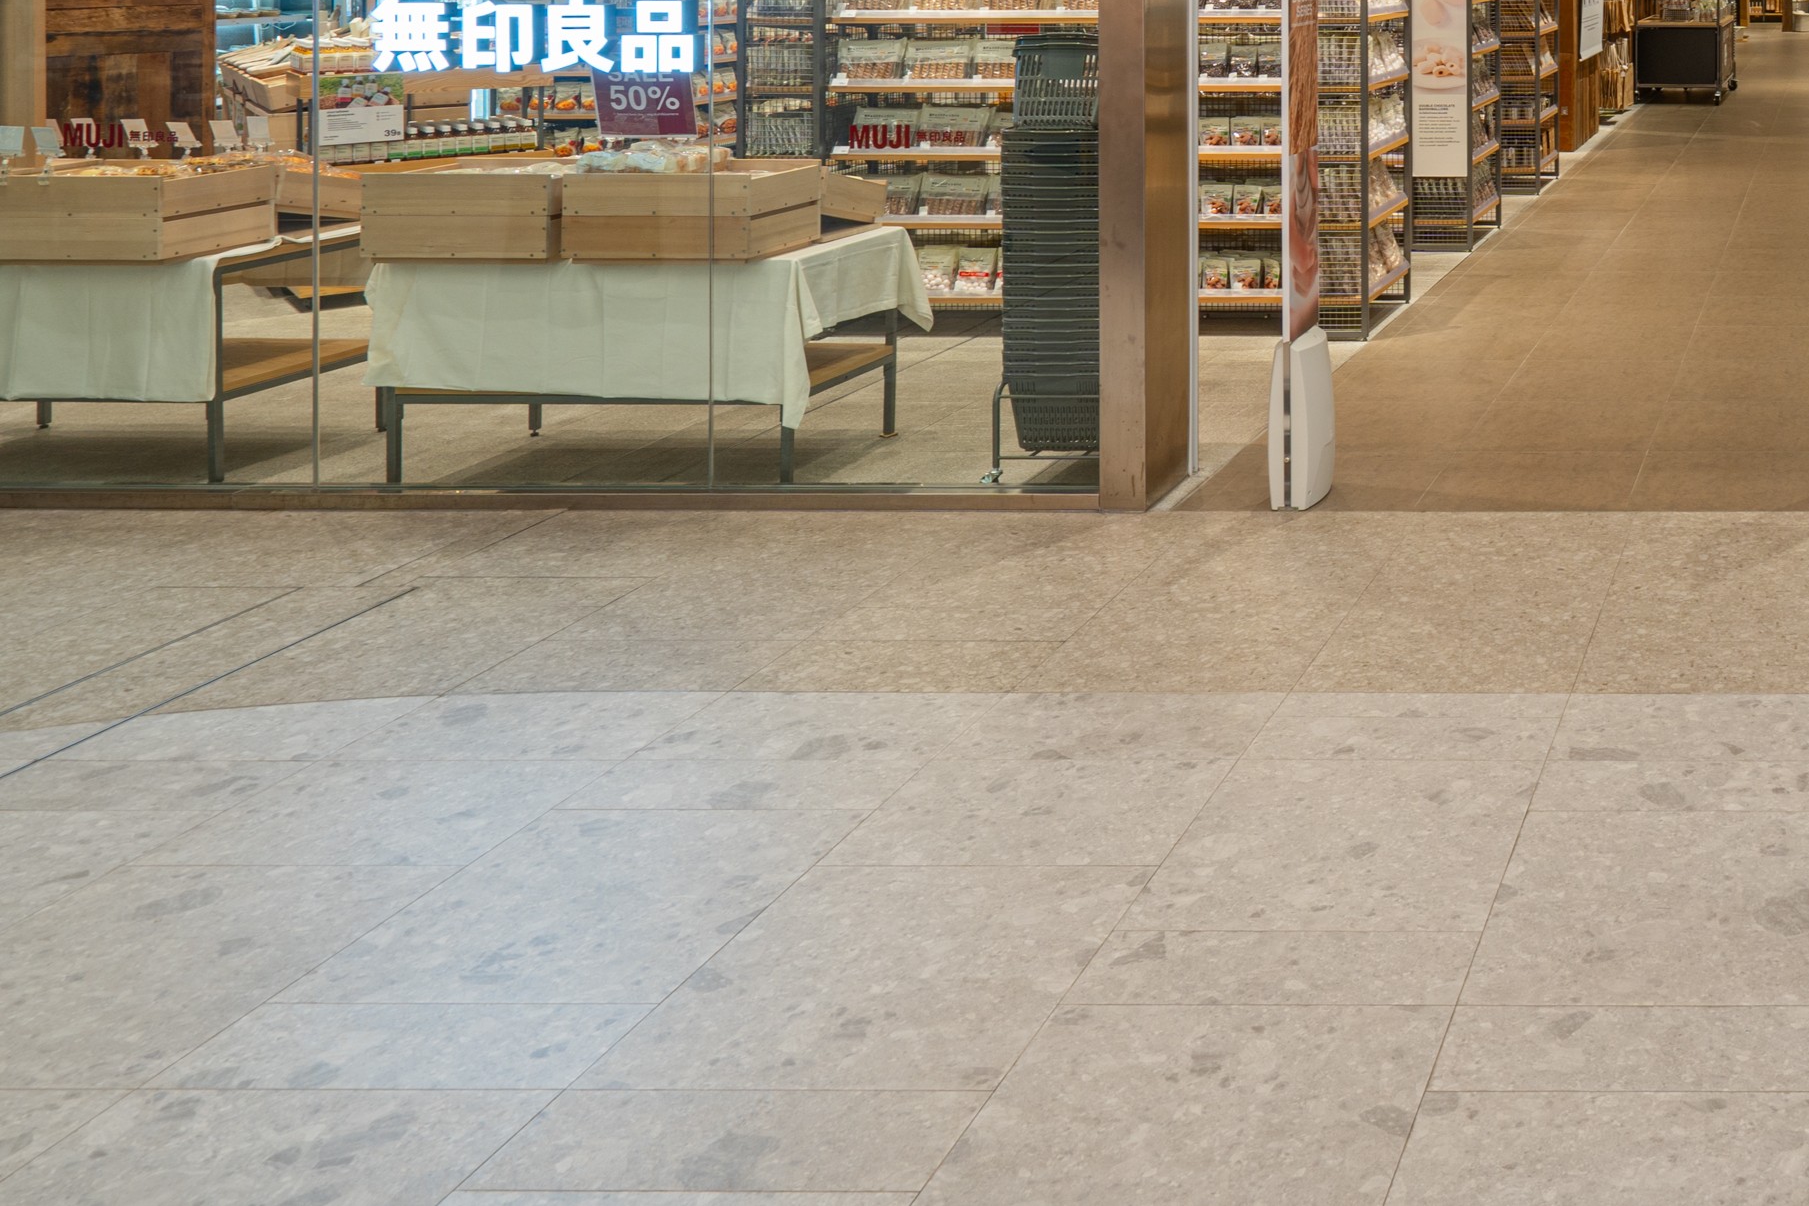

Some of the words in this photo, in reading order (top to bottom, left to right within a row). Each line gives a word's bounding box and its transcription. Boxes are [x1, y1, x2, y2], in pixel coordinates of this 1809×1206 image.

[610, 85, 680, 111] 50%
[63, 122, 123, 148] MUJI
[129, 130, 179, 143] 無印良品
[849, 124, 911, 149] MUJI
[916, 130, 967, 143] 無印良品
